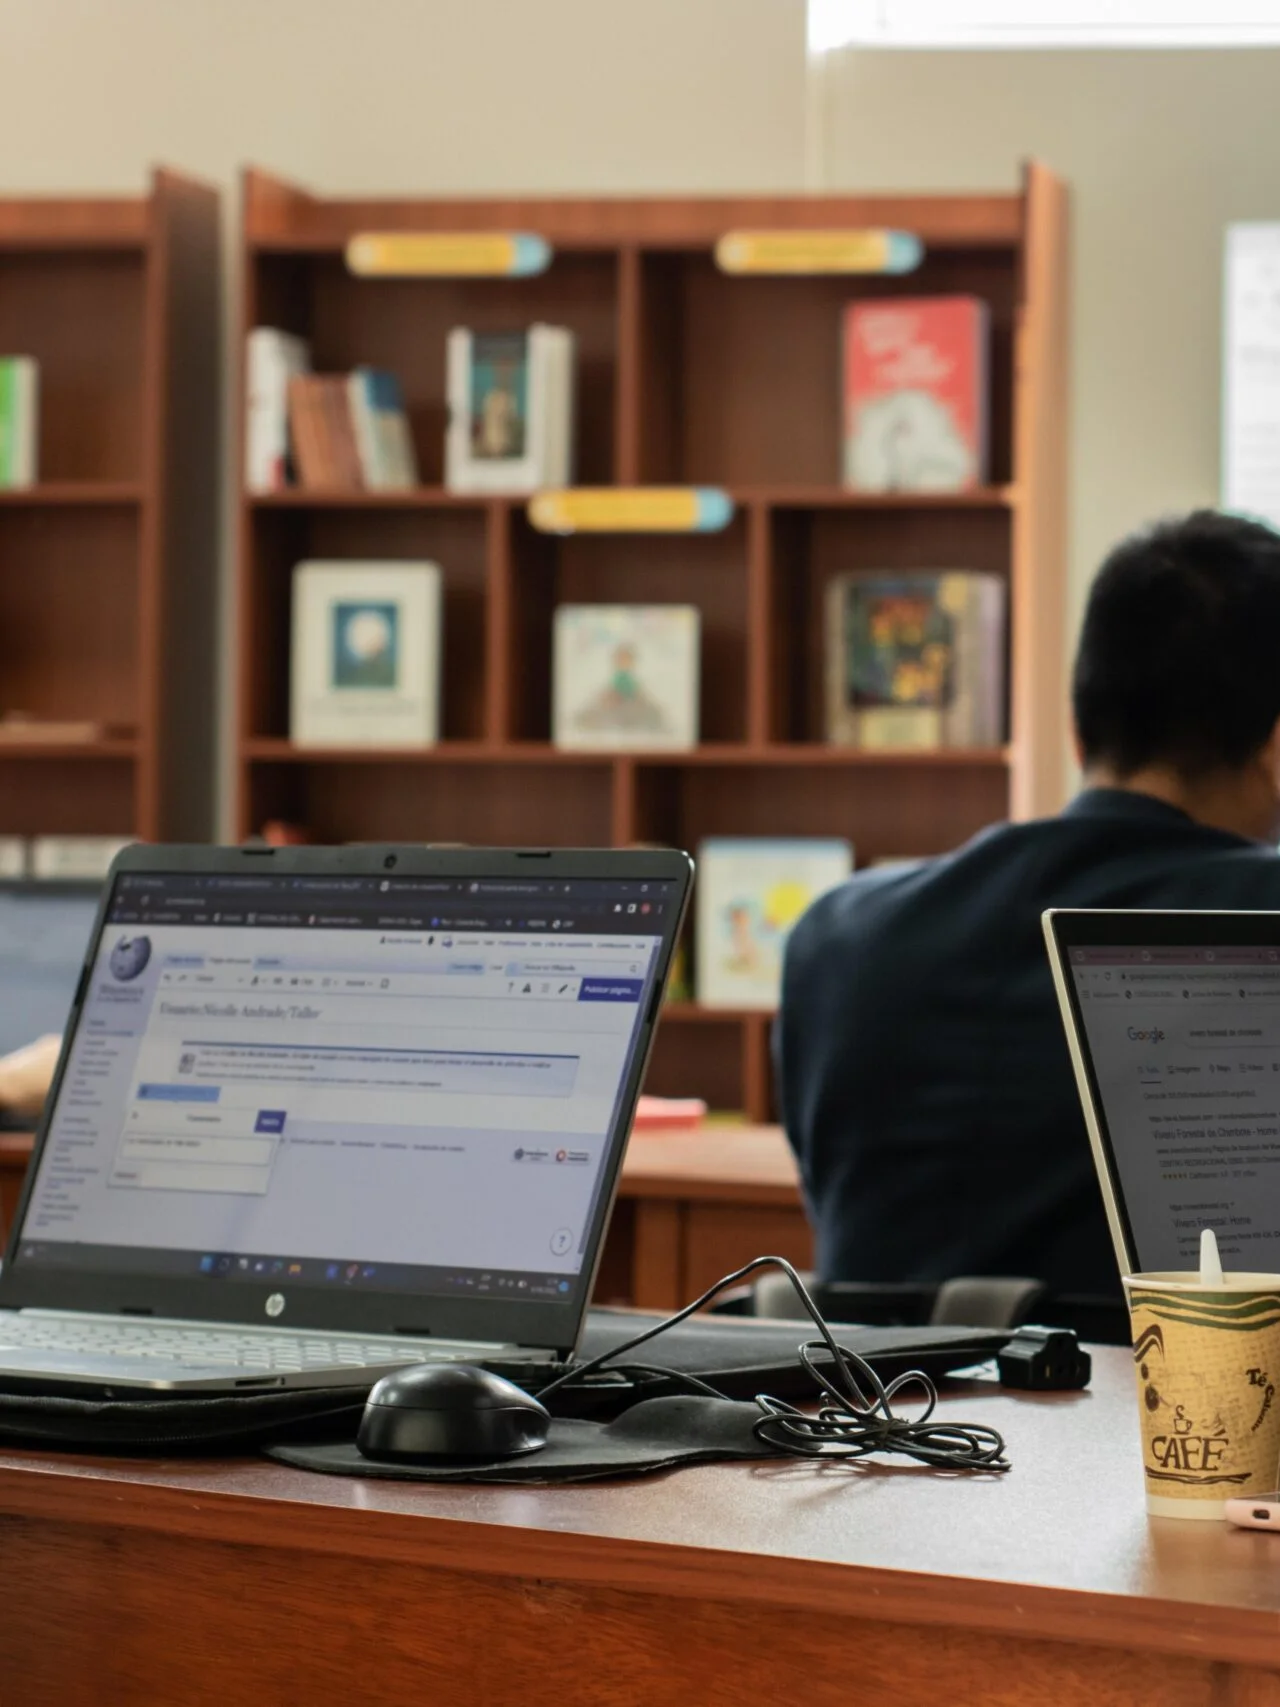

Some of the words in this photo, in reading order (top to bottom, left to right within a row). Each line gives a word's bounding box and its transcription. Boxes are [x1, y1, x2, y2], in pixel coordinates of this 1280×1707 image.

[1127, 1026, 1165, 1044] Google
[1153, 1129, 1176, 1140] Vivero
[1177, 1128, 1206, 1139] Forestal
[1218, 1126, 1251, 1137] Chimbote
[1257, 1126, 1279, 1136] Home
[1173, 1218, 1197, 1228] Vivero
[1230, 1215, 1251, 1225] Home
[1245, 1367, 1268, 1388] Té
[1151, 1428, 1230, 1472] CAFÉ
